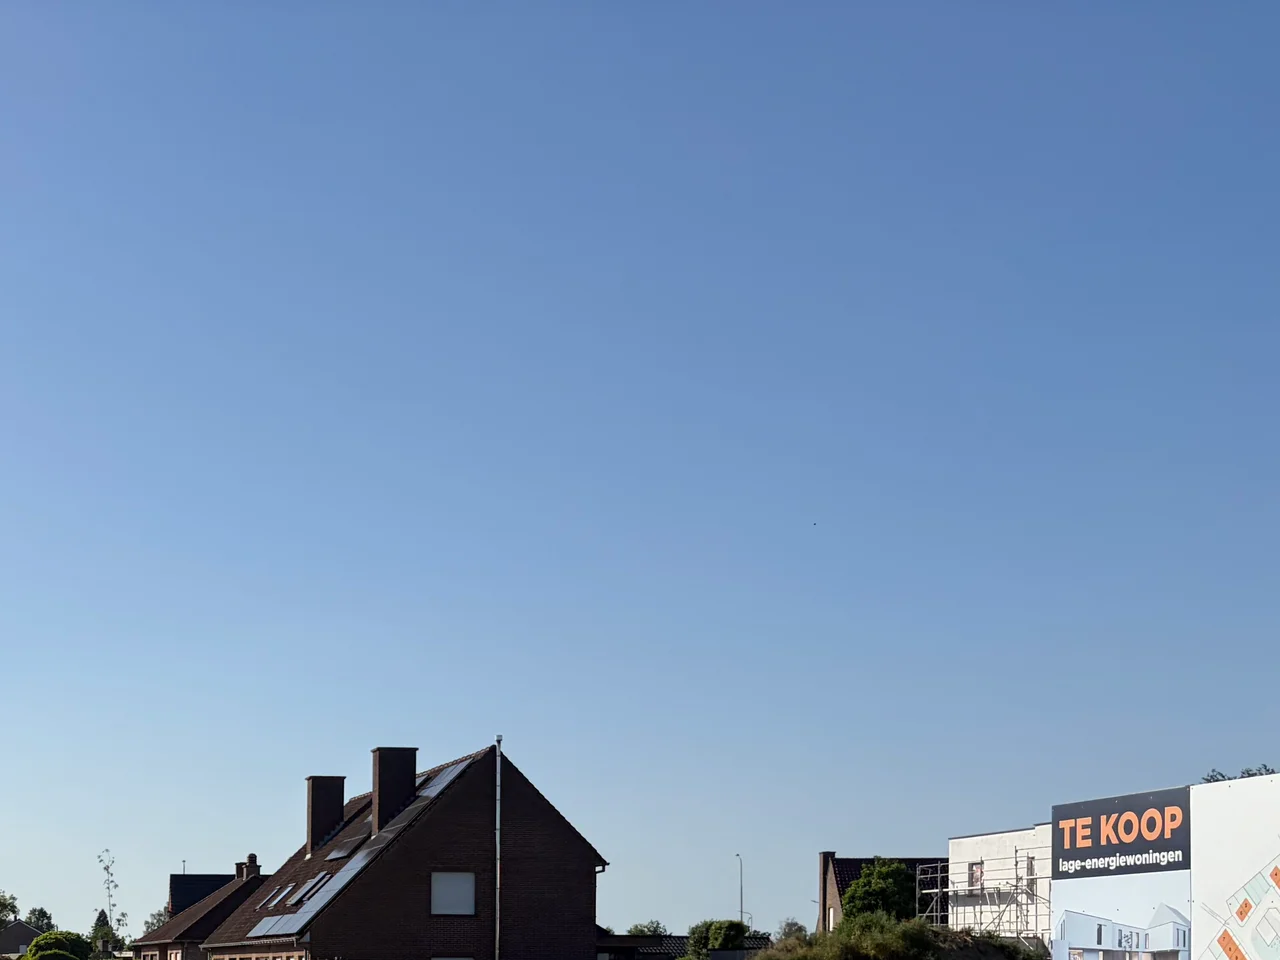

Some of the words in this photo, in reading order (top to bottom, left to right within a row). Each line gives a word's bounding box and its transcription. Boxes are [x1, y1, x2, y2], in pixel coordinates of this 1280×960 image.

[1058, 816, 1093, 849] TE
[1100, 805, 1183, 846] KOOP
[1058, 849, 1183, 873] lage-energiewoningen
